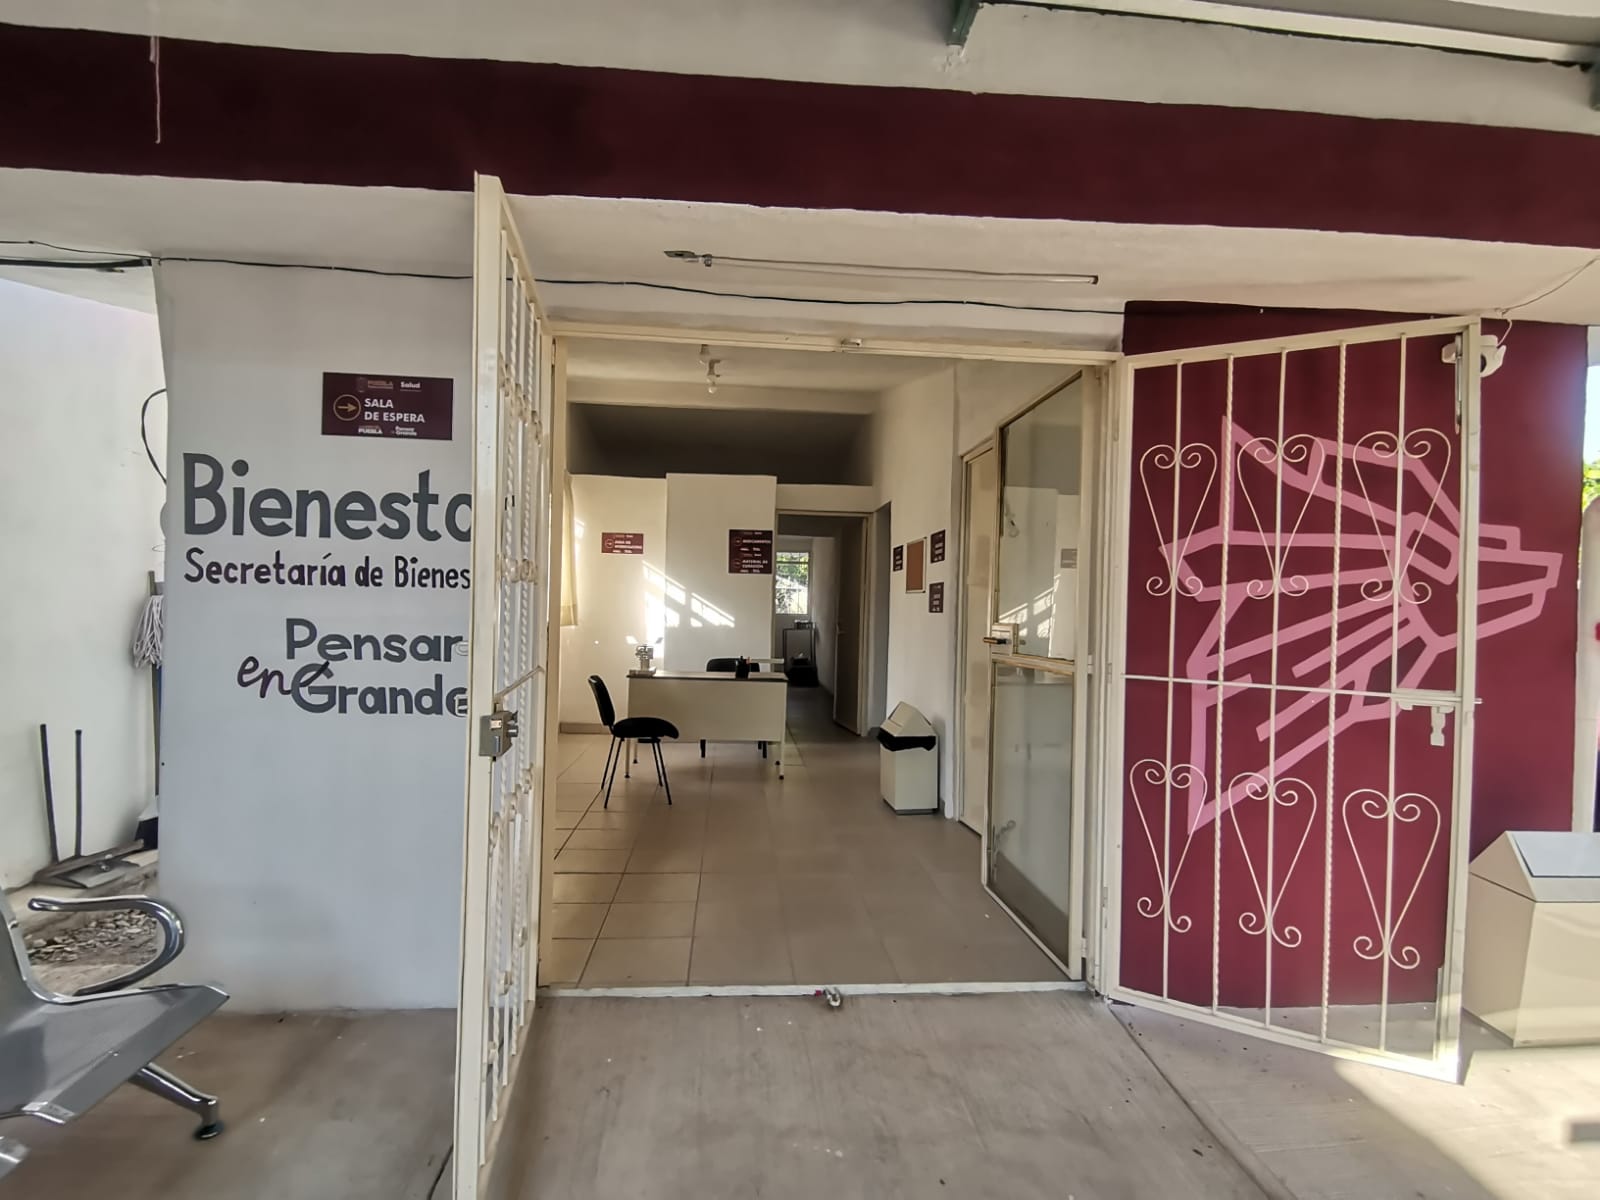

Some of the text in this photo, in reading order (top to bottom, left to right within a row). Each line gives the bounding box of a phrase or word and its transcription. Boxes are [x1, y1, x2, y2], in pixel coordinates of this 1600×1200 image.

[364, 398, 394, 409] SALA
[364, 411, 426, 423] DE ESPERA
[184, 547, 470, 589] Secretaría de Bienes
[286, 618, 463, 662] Pensar
[237, 656, 320, 699] en
